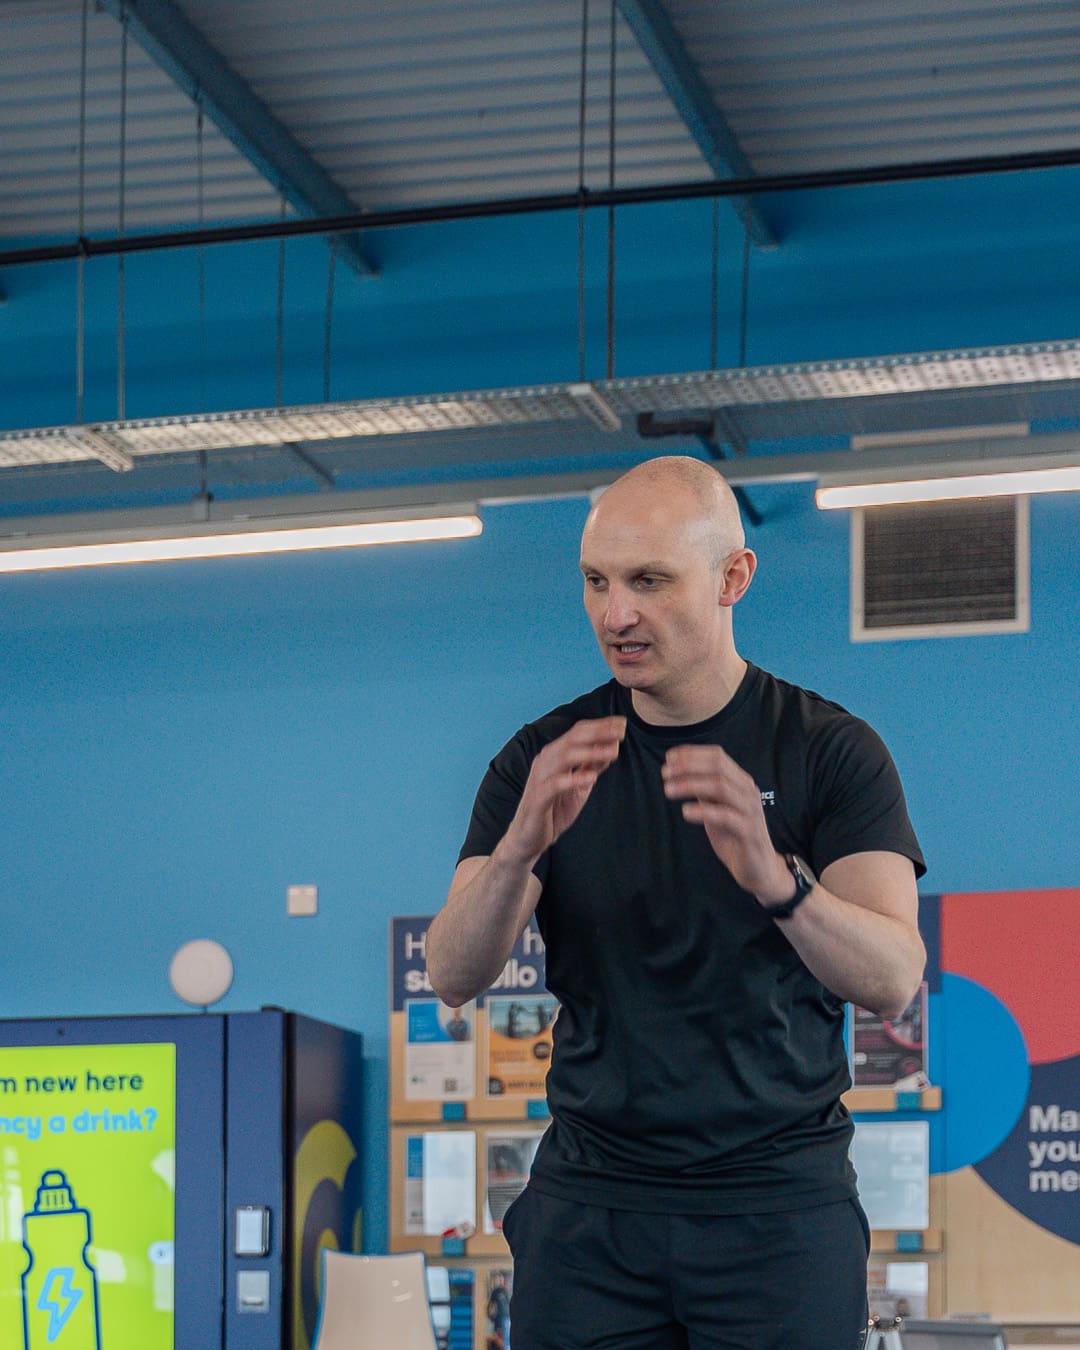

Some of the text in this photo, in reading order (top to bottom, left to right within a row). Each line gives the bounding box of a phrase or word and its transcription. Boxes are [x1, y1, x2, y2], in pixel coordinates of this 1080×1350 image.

[26, 1076, 77, 1093] new
[86, 1069, 144, 1091] here
[48, 1115, 66, 1133] a
[72, 1108, 158, 1133] drink?
[1029, 1104, 1080, 1132] Ma
[1029, 1170, 1080, 1192] me
